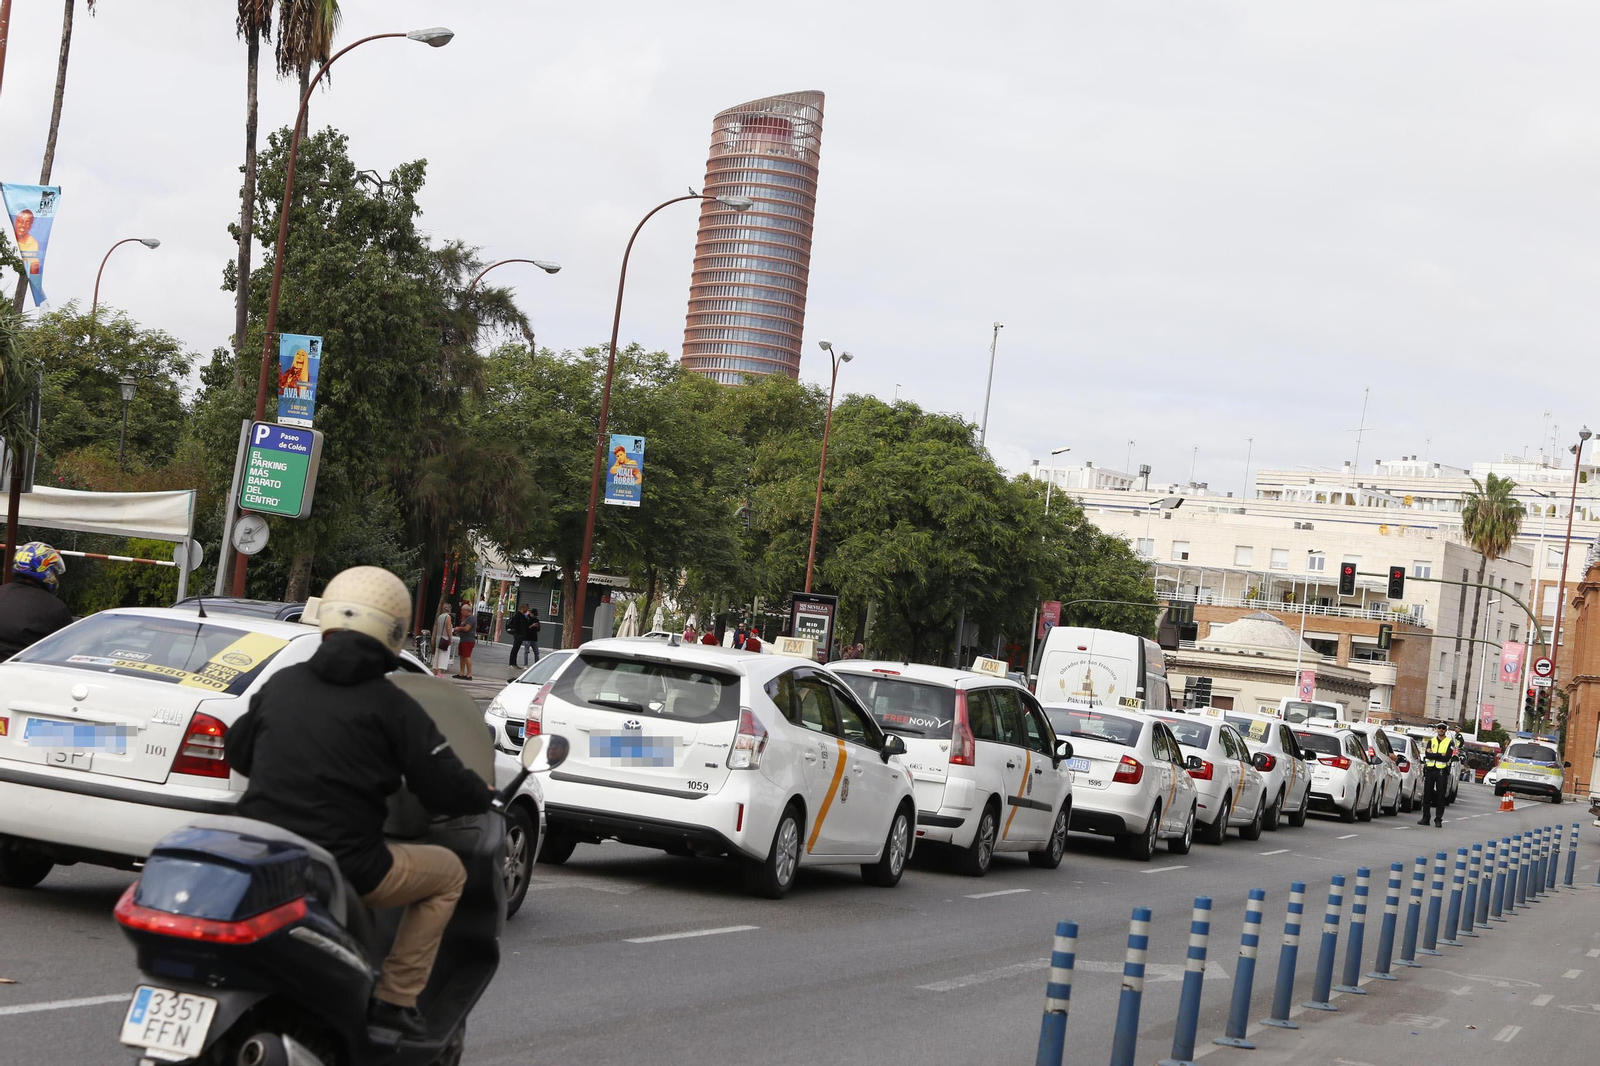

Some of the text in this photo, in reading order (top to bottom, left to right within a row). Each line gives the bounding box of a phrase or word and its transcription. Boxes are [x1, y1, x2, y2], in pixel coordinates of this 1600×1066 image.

[283, 387, 313, 401] AVA MAX
[255, 424, 271, 445] P
[280, 432, 300, 442] Paseo
[278, 441, 307, 452] de Colón
[252, 450, 263, 459] EL
[251, 458, 288, 471] PARKING
[249, 467, 269, 478] MÁS
[616, 468, 634, 477] NIALL
[247, 476, 282, 489] BARATO
[613, 476, 635, 486] HORAN
[246, 485, 263, 495] DEL
[785, 640, 804, 652] TAXI
[208, 663, 239, 676] RADIO
[982, 660, 999, 672] TAXI
[1059, 661, 1079, 675] Obrador
[1098, 661, 1117, 681] Francisco
[114, 660, 148, 669] 954
[153, 666, 188, 678] 580
[192, 675, 223, 688] 000
[203, 667, 235, 681] TAXI
[1124, 698, 1139, 709] TAXI
[145, 744, 167, 757] 1101
[1069, 760, 1087, 769] JHB
[687, 780, 709, 791] 1059
[1087, 779, 1102, 787] 1595
[149, 993, 206, 1023] 3351
[143, 1019, 191, 1047] FFN
